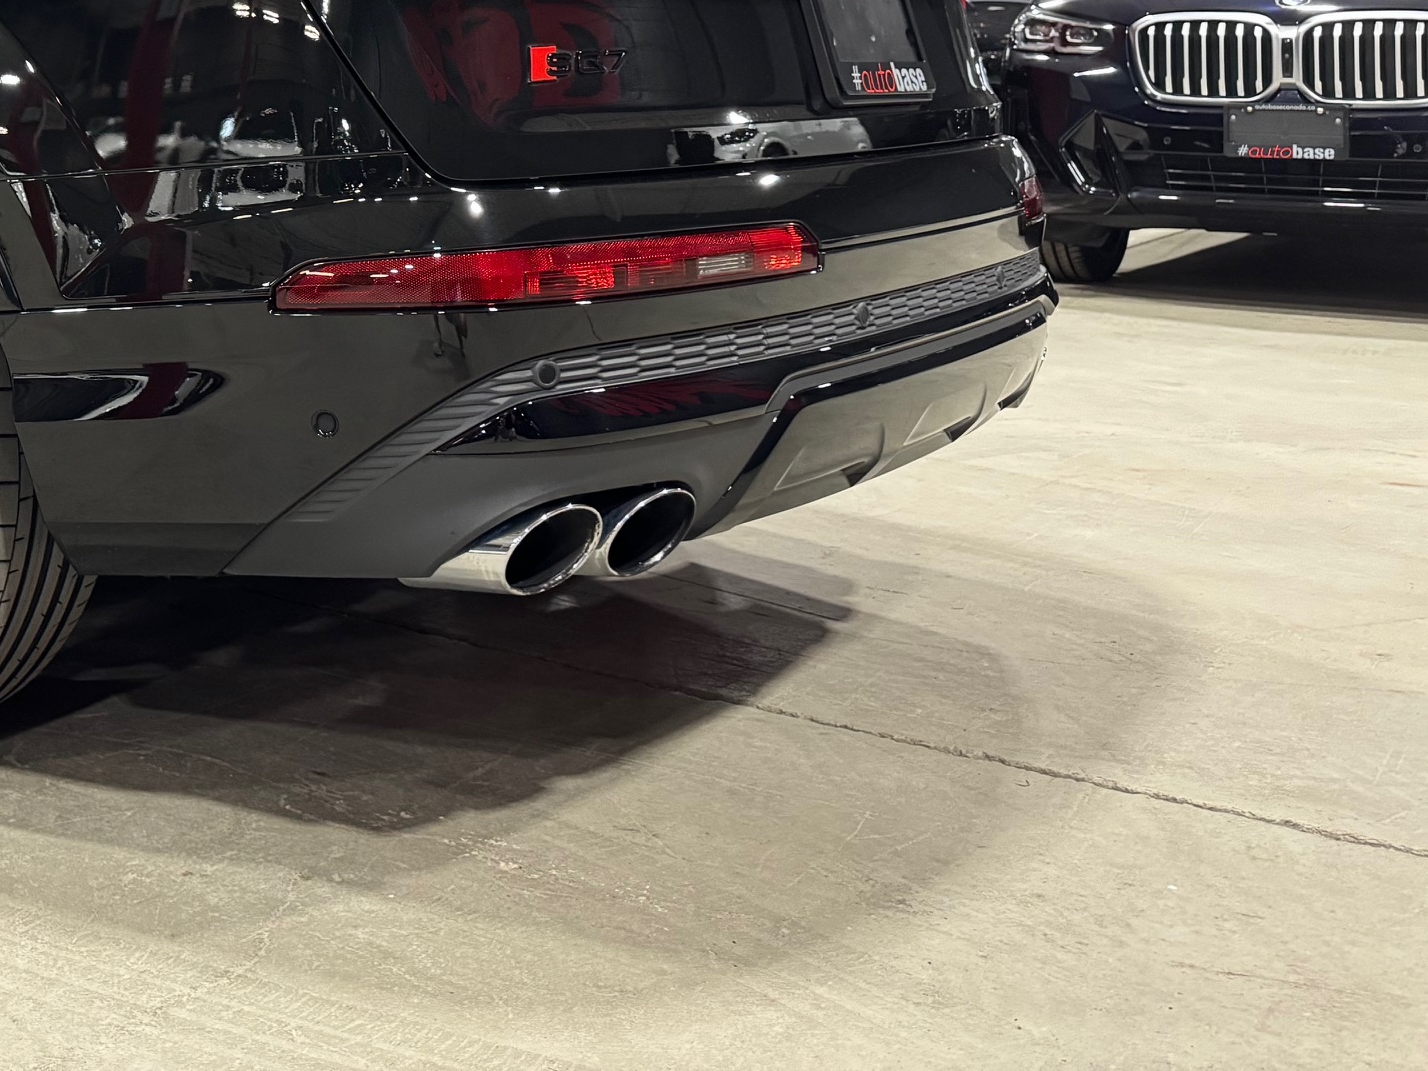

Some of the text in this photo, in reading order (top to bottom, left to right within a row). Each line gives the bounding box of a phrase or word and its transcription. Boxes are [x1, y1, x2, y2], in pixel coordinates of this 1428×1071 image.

[546, 47, 627, 78] SQ7
[851, 61, 927, 93] #autobase
[1237, 143, 1335, 160] #autobase
